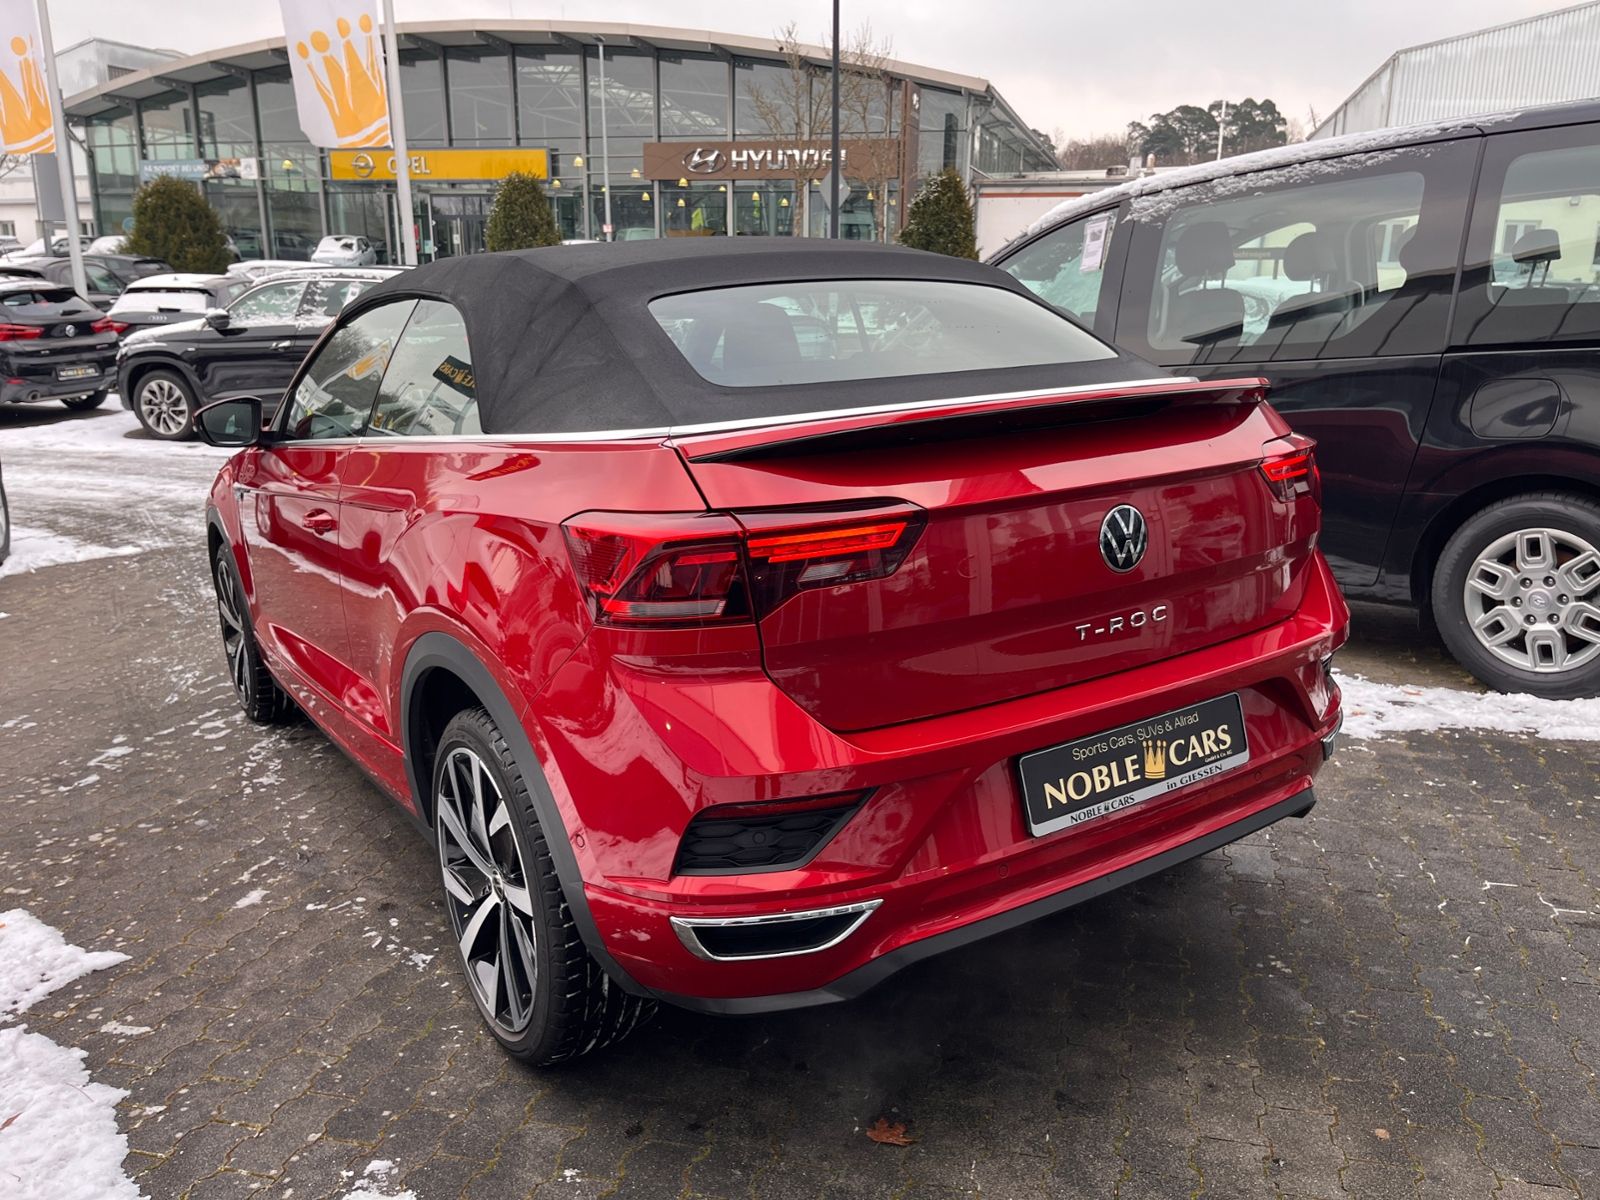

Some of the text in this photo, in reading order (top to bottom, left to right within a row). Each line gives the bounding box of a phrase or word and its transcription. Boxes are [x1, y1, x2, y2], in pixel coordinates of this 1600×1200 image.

[387, 156, 431, 174] OEL
[731, 149, 847, 170] HYUNDAI
[1075, 605, 1167, 641] T-ROC
[1072, 711, 1199, 761] Sports Cars, SUVs & Allrad
[1043, 724, 1232, 810] NOBLE CARS
[1166, 763, 1223, 791] in GIESSEN
[1070, 794, 1136, 824] NOBLE CARS
